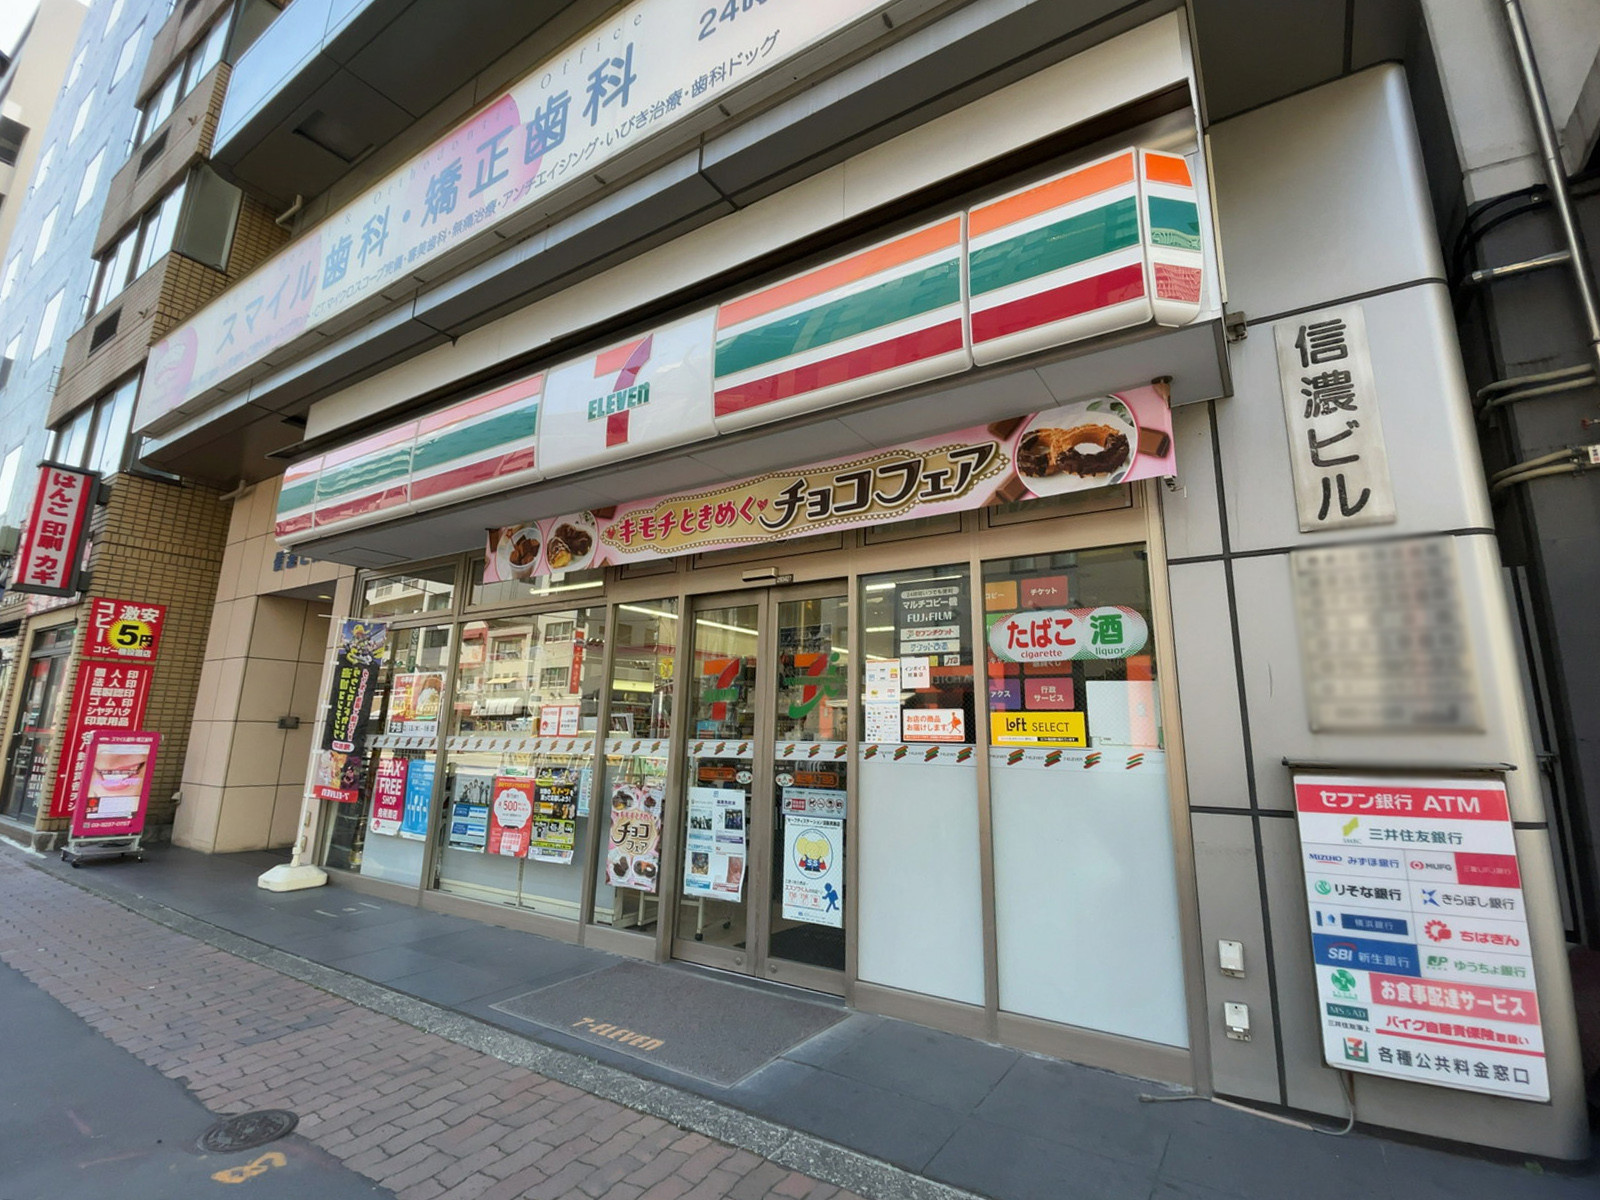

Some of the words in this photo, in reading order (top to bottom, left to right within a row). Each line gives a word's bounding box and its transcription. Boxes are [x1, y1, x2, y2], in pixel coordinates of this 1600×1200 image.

[540, 13, 643, 89] Office
[1294, 318, 1371, 521] 信濃ビル
[47, 471, 78, 518] はんこ
[617, 495, 757, 545] キモチときめく
[759, 440, 998, 532] チョコフェア
[36, 519, 67, 552] 印刷
[30, 554, 59, 585] カギ
[1030, 587, 1058, 596] チケット
[902, 596, 958, 610] マルチコピー機
[119, 604, 160, 623] 激安
[1007, 617, 1076, 650] たばこ
[1089, 613, 1124, 645] 酒
[1020, 649, 1063, 660] cigarette
[1095, 645, 1127, 657] liquor
[94, 667, 139, 679] 個人印
[92, 678, 137, 689] 法人印
[88, 697, 134, 707] ゴム印
[1034, 694, 1065, 703] サービス
[1032, 722, 1070, 732] SELECT
[379, 777, 403, 796] FREE
[381, 795, 397, 806] SHOP
[503, 800, 518, 812] 500
[1319, 790, 1413, 811] セブン銀行
[1423, 795, 1481, 814] ATM
[611, 820, 650, 844] チョコ
[1368, 827, 1463, 845] 三井住友銀行
[626, 840, 648, 852] フェア
[1309, 853, 1343, 863] MIZUHO
[1347, 855, 1400, 869] みずほ銀行
[1425, 862, 1453, 872] MUFG
[1334, 883, 1402, 901] りそな銀行
[1441, 894, 1515, 911] きらぼし銀行
[1354, 918, 1394, 931] 横浜銀行
[1327, 947, 1353, 962] SBI
[1358, 951, 1411, 969] 新生銀行
[1454, 960, 1527, 978] ゆうちょ銀行
[1380, 980, 1527, 1017] お食事配達サービス
[1378, 1046, 1530, 1085] 各種公共料金窓口
